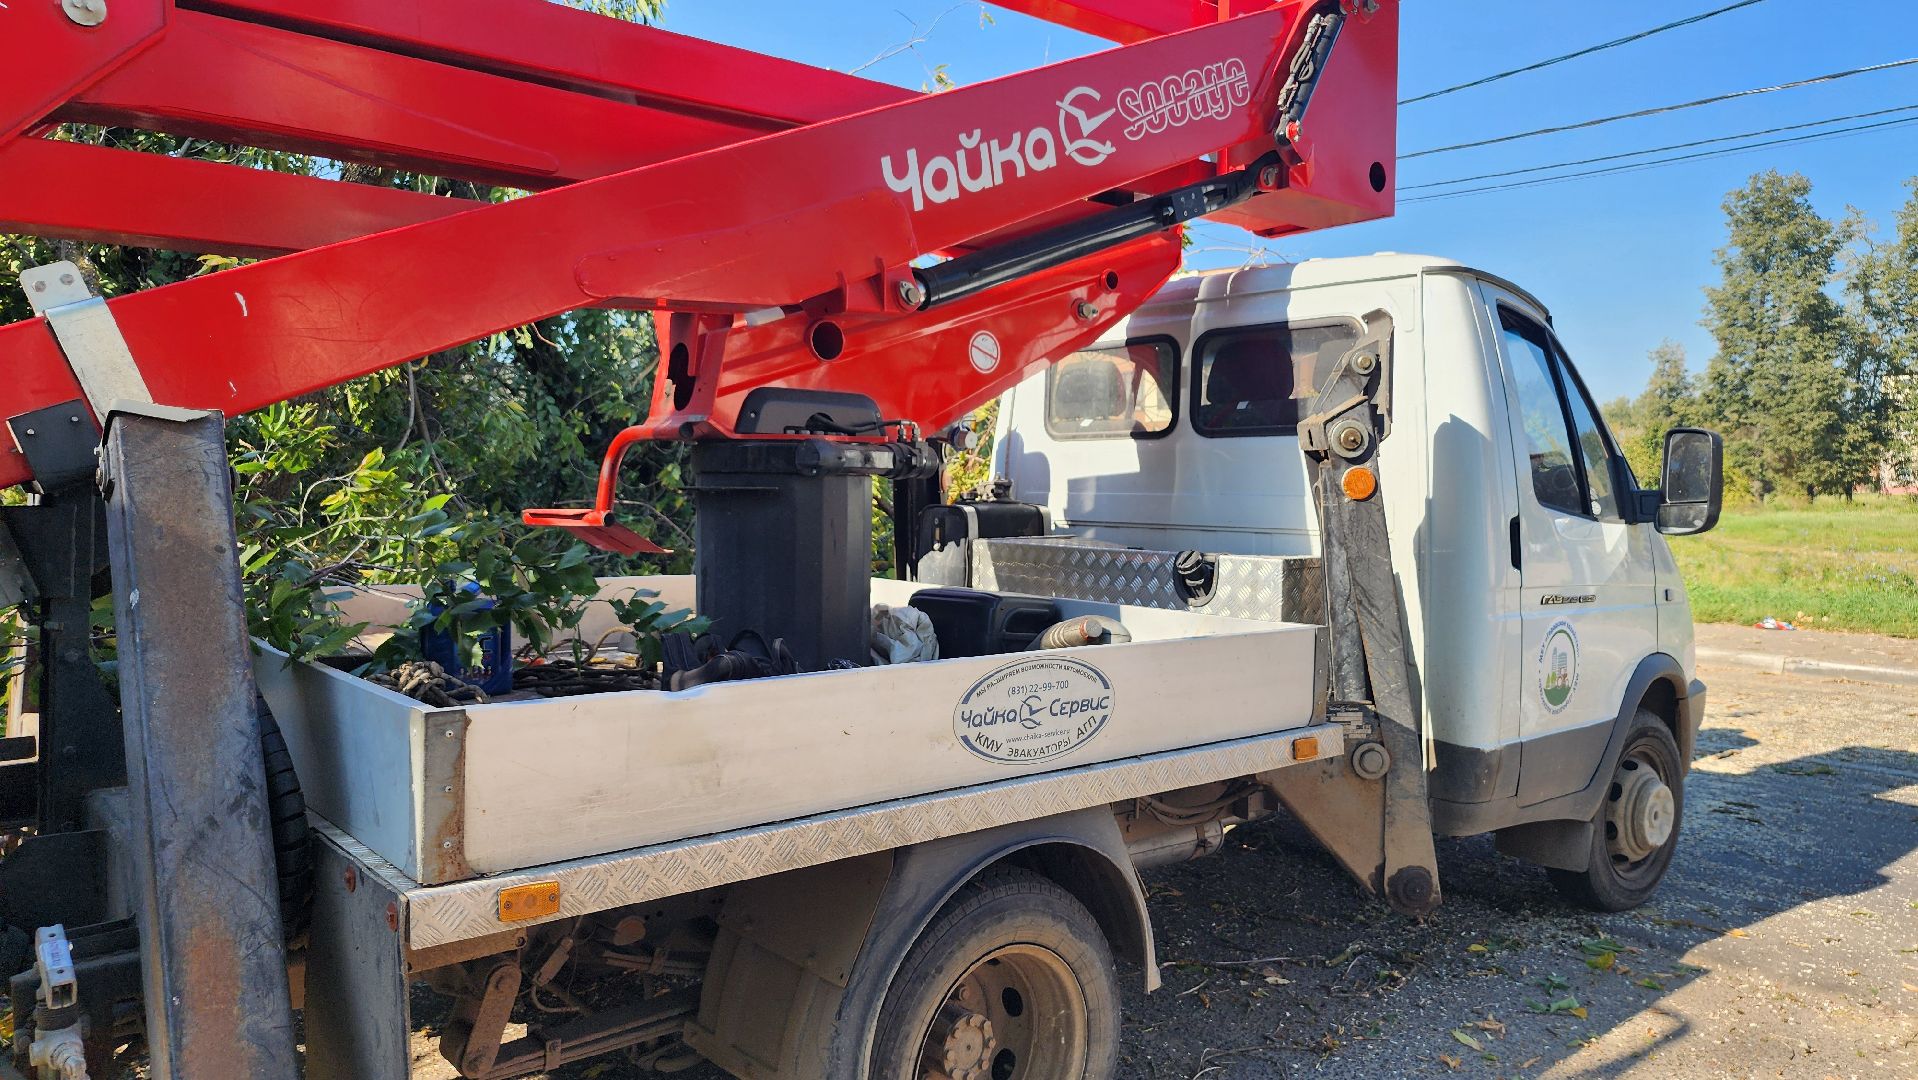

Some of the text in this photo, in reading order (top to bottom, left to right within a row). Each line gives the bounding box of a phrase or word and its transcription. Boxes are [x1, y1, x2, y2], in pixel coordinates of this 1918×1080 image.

[881, 128, 1057, 211] Чайка
[1007, 680, 1069, 698] (831) 22-99-700
[961, 695, 1110, 728] Чайка Сервис
[974, 715, 1097, 758] КМУ ЭВАКУАТОРЫ АГП
